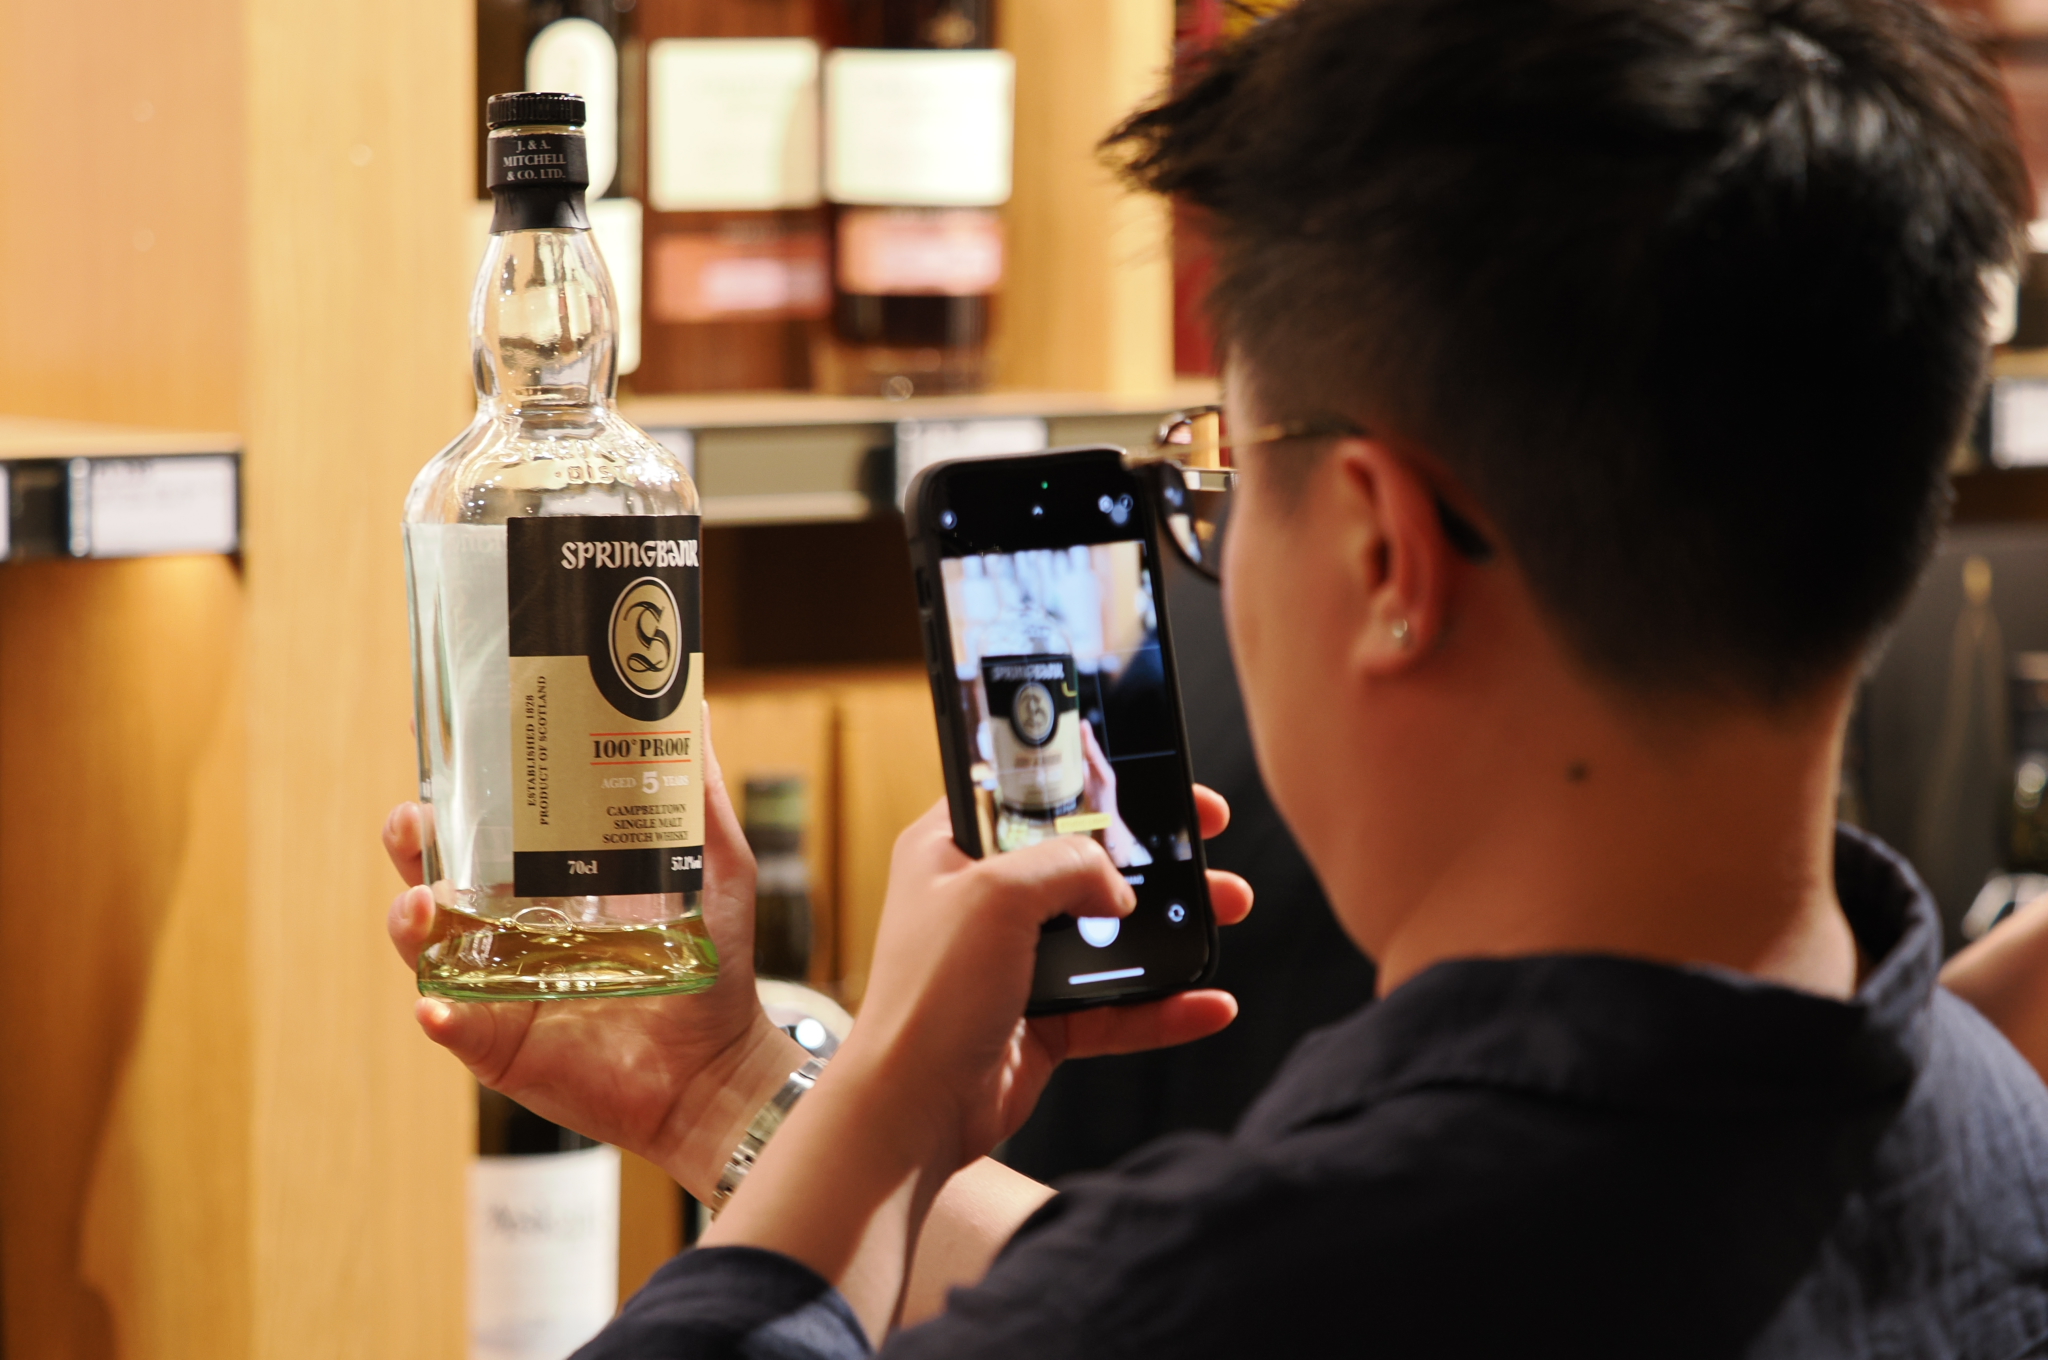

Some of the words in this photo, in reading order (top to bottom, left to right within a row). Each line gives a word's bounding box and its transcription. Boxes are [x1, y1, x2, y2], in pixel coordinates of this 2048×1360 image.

[527, 140, 537, 150] &
[503, 154, 567, 167] MITCHELL
[506, 171, 515, 181] &
[517, 170, 538, 180] CO.
[540, 168, 566, 179] LTD.
[561, 539, 699, 570] SPRINGBANK
[525, 694, 535, 719] 1828
[537, 675, 547, 742] SCOTLAND
[538, 745, 548, 762] OF
[639, 738, 690, 757] PROOF
[525, 723, 536, 807] ESTABLISHED
[601, 777, 637, 789] AGED
[642, 770, 660, 794] 5
[538, 767, 549, 826] PRODUCT
[606, 803, 687, 816] CAMPBELTOWN
[614, 818, 655, 830] SINGLE
[658, 817, 683, 828] MALT
[602, 832, 653, 844] SCOTCH
[567, 860, 598, 874] 70cl
